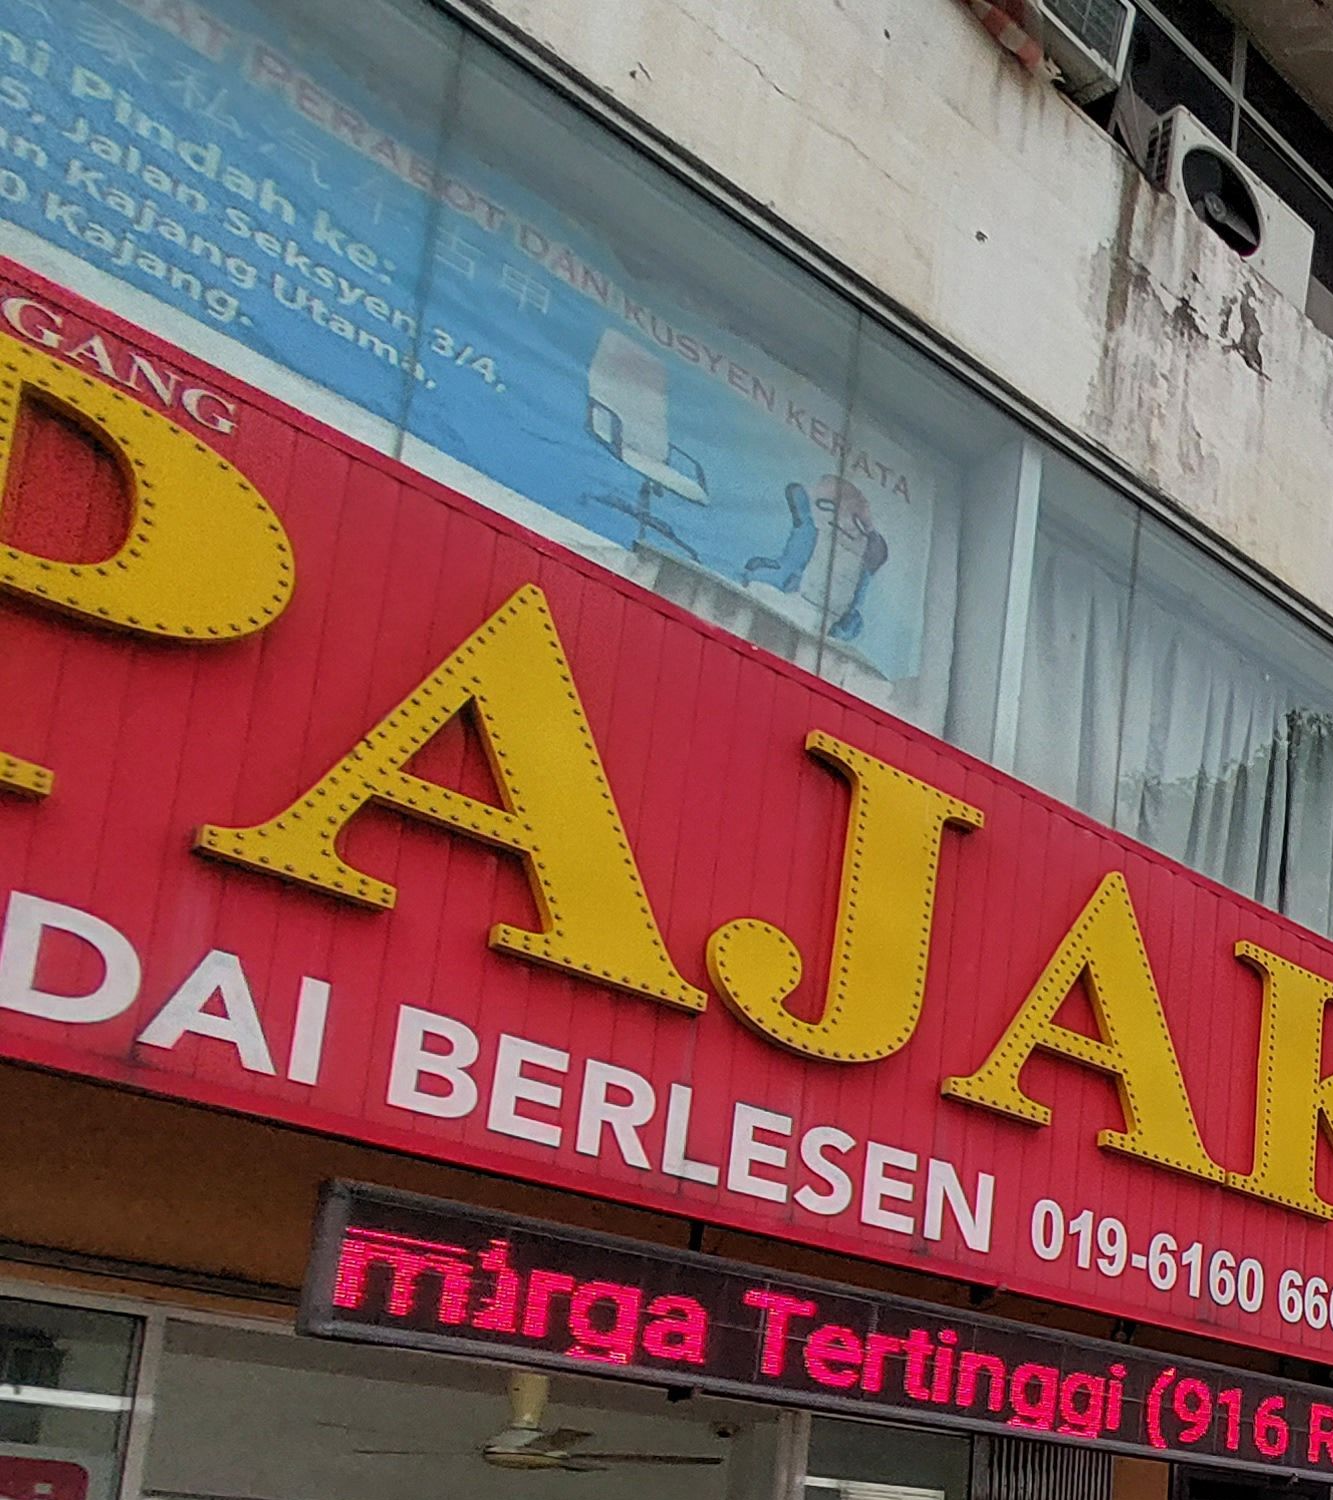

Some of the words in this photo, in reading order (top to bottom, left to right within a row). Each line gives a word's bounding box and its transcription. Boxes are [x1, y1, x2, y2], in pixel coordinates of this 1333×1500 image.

[45, 192, 252, 328] Kajang.
[63, 117, 209, 213] Jalan
[224, 207, 417, 337] Seksyen
[430, 325, 506, 392] 3/4,
[67, 158, 258, 291] Kajang
[273, 273, 437, 390] Utama,
[72, 65, 296, 226] Pindah
[313, 209, 397, 285] ke:
[3, 294, 238, 436] GANG
[518, 222, 611, 305] DAN
[624, 296, 776, 413] KUSYEN
[785, 401, 911, 505] KERATA
[1, 890, 331, 1086] DAI
[386, 1004, 995, 1253] BERLESEN
[1031, 1201, 1265, 1313] 019-6160
[742, 1288, 1126, 1440] Tertinggi
[1146, 1366, 1290, 1460] (916
